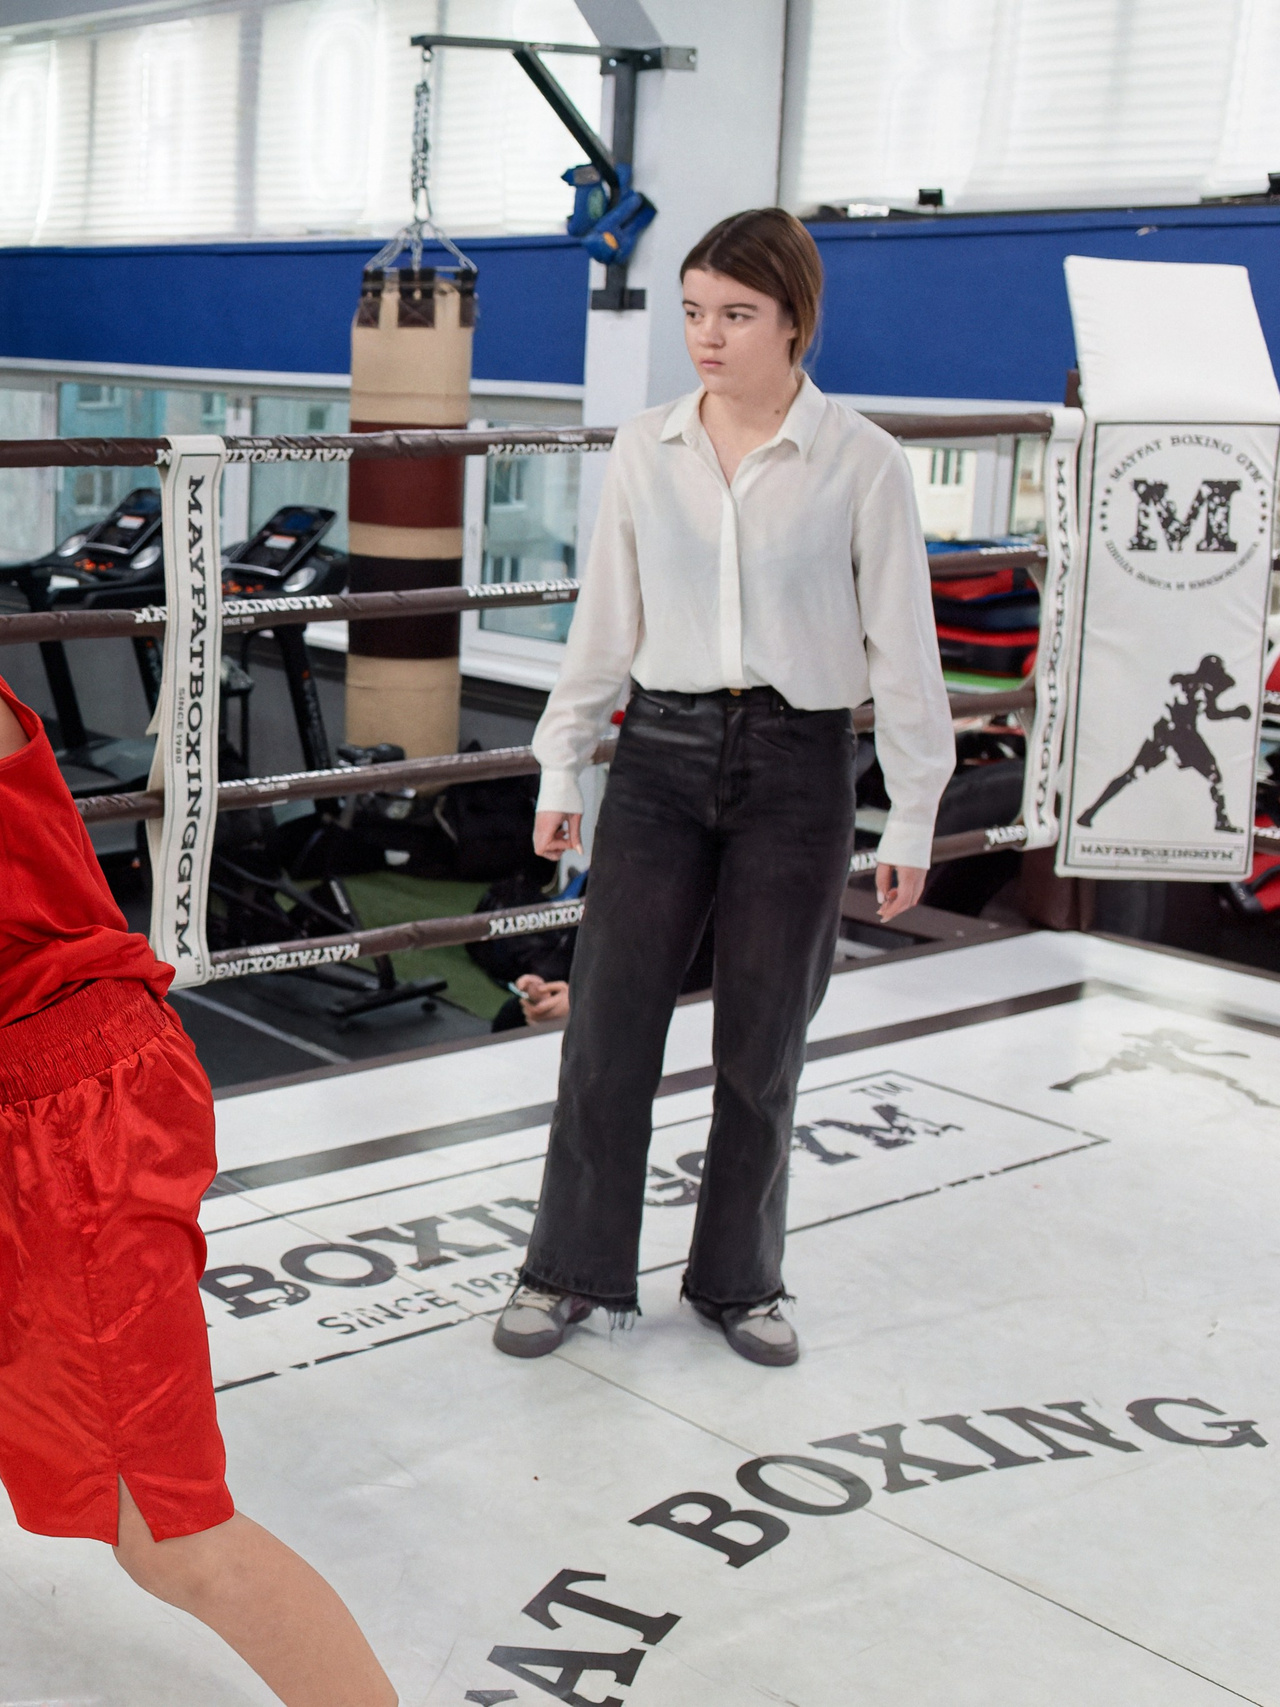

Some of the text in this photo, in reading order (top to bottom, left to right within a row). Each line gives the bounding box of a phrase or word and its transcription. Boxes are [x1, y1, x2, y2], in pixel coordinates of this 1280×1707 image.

[1170, 433, 1233, 455] BOXING
[175, 474, 207, 959] MAYFATBOXINGGYM
[317, 1289, 460, 1335] SINCE
[628, 1396, 1272, 1570] BOXING
